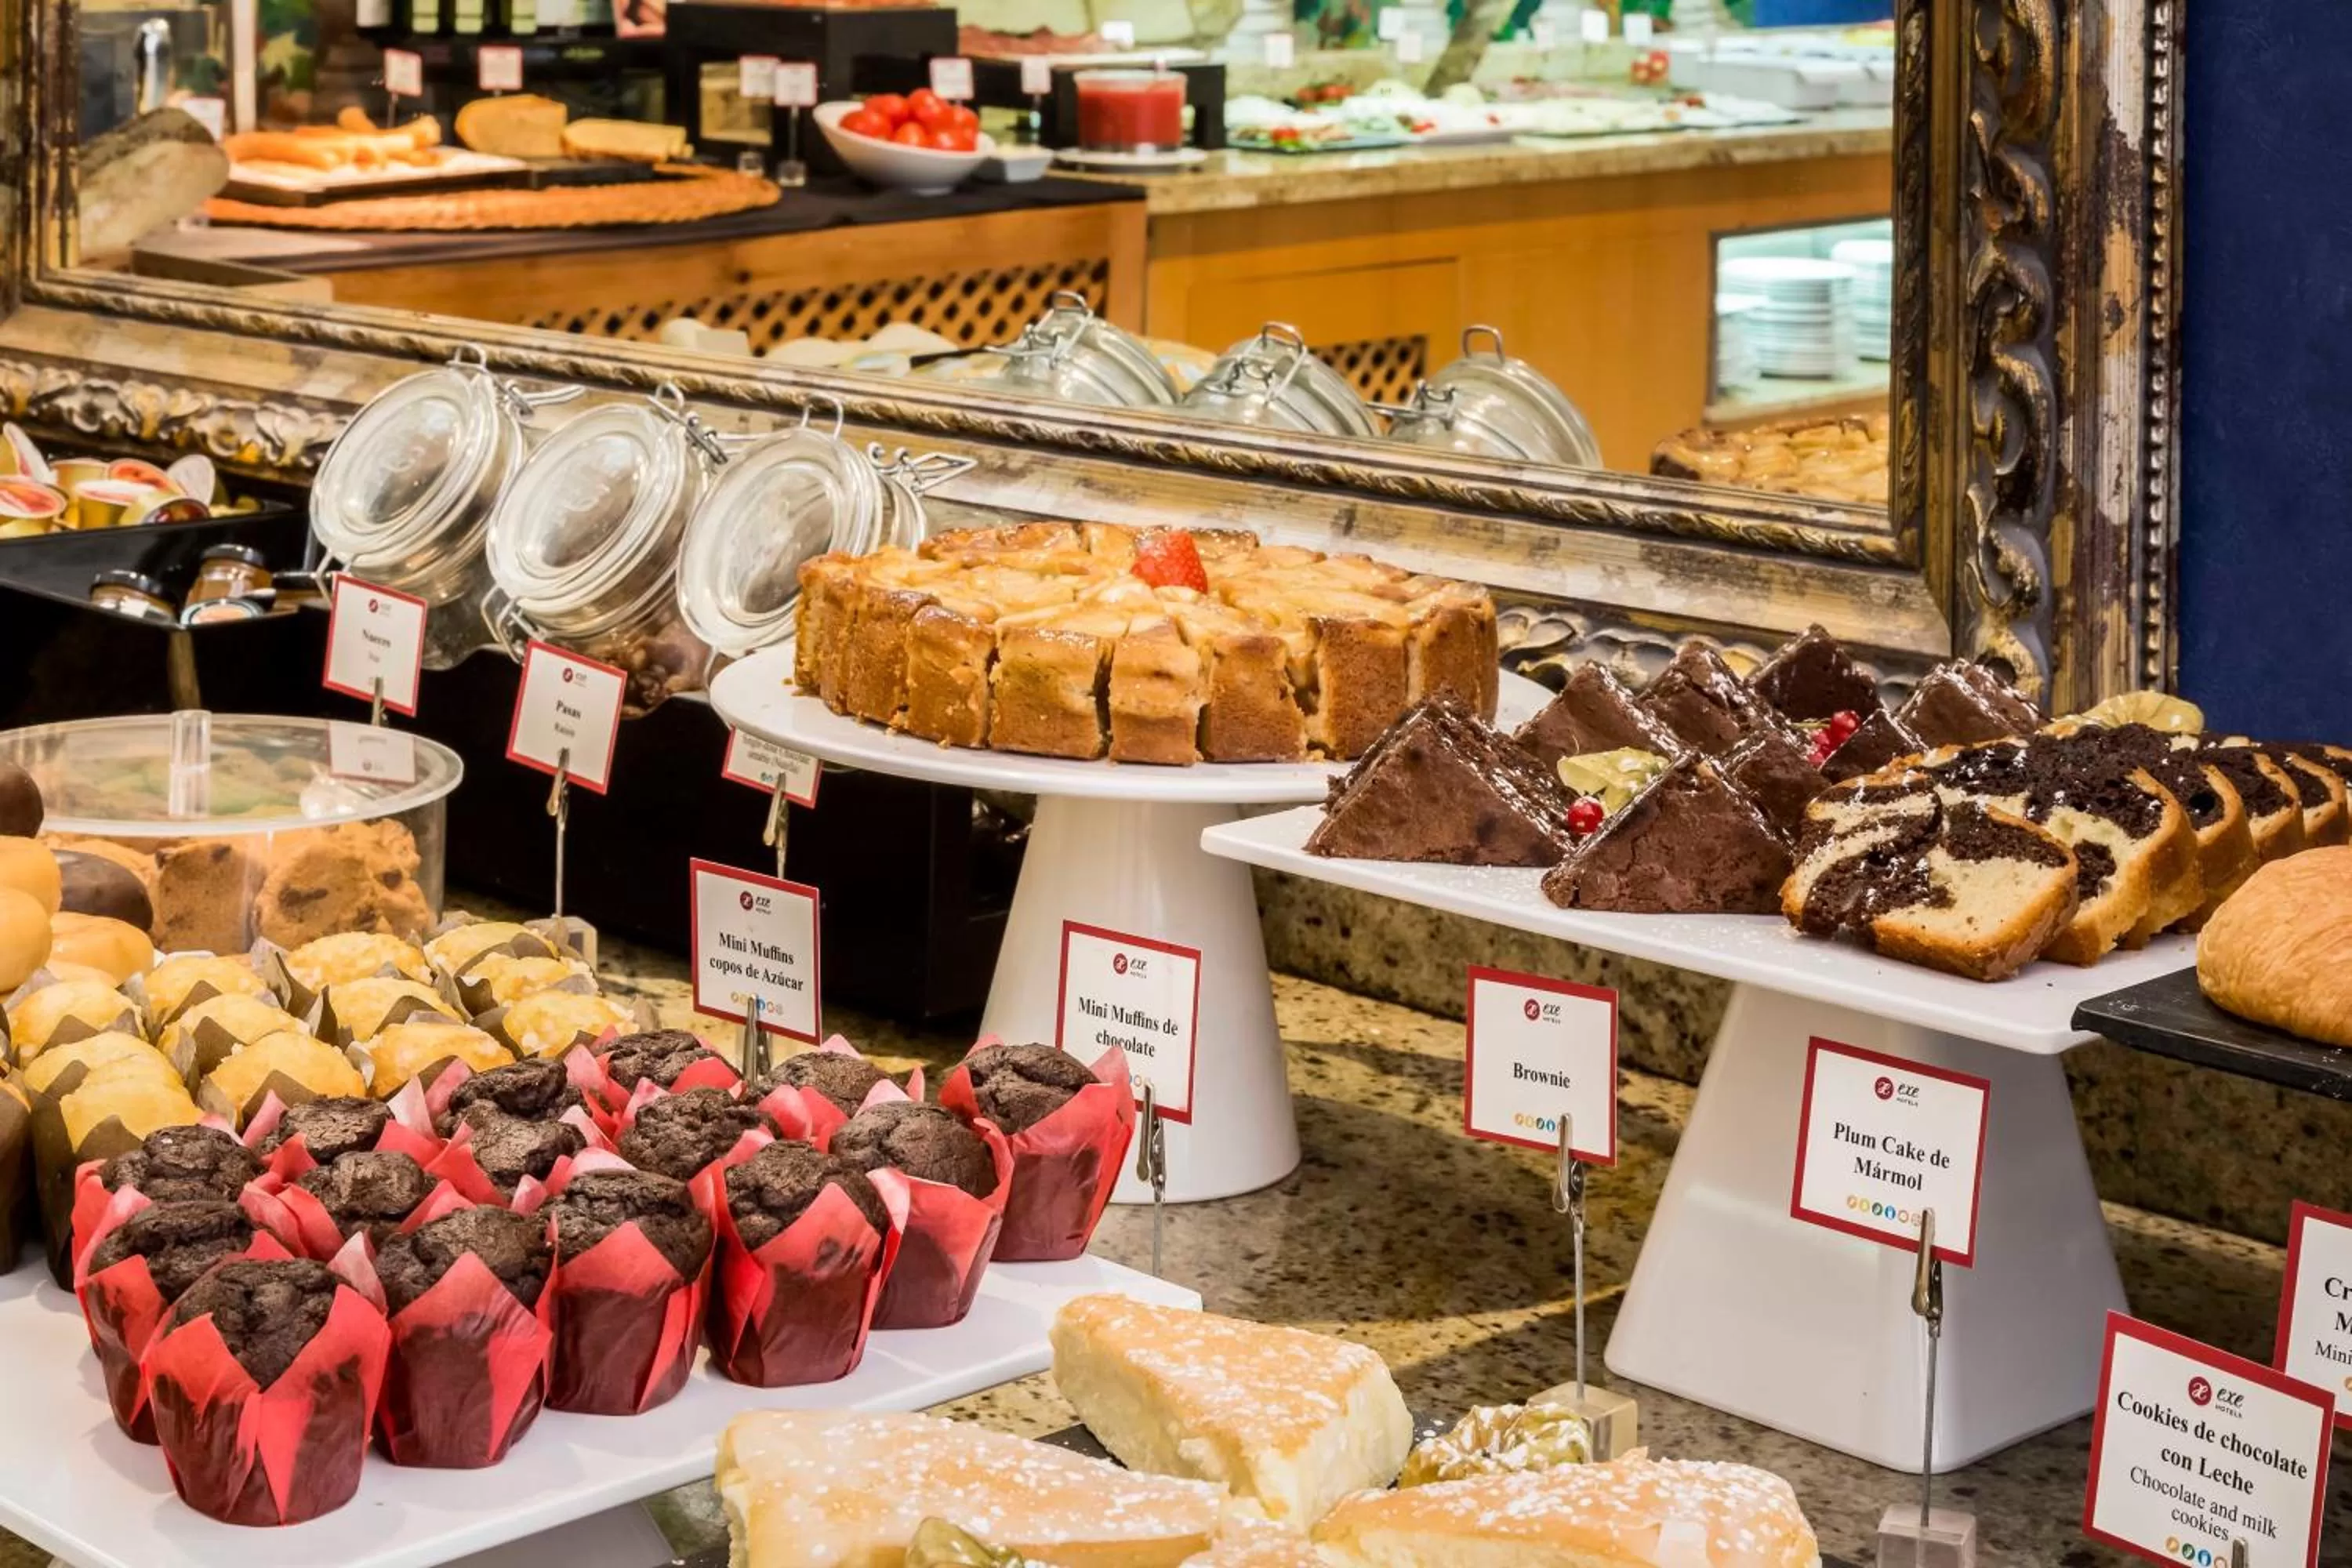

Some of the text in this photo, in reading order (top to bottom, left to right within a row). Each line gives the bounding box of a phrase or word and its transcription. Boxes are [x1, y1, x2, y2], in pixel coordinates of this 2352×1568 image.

[718, 932, 794, 965] Mini Muffins
[710, 955, 804, 991] copos de Azúcar
[1078, 996, 1178, 1036] Mini Muffins de
[1096, 1029, 1155, 1058] chocolate
[1513, 1062, 1570, 1089] Brownie
[1897, 1083, 1920, 1098] exe
[1834, 1122, 1950, 1169] Plum Cake de
[1854, 1156, 1922, 1191] Mármol
[2215, 1405, 2243, 1418] HOTELS
[2216, 1388, 2245, 1406] exe
[2117, 1391, 2308, 1480] Cookies de chocolate
[2161, 1446, 2254, 1495] con Leche
[2130, 1465, 2278, 1540] Chocolate and milk
[2171, 1506, 2230, 1542] cookies
